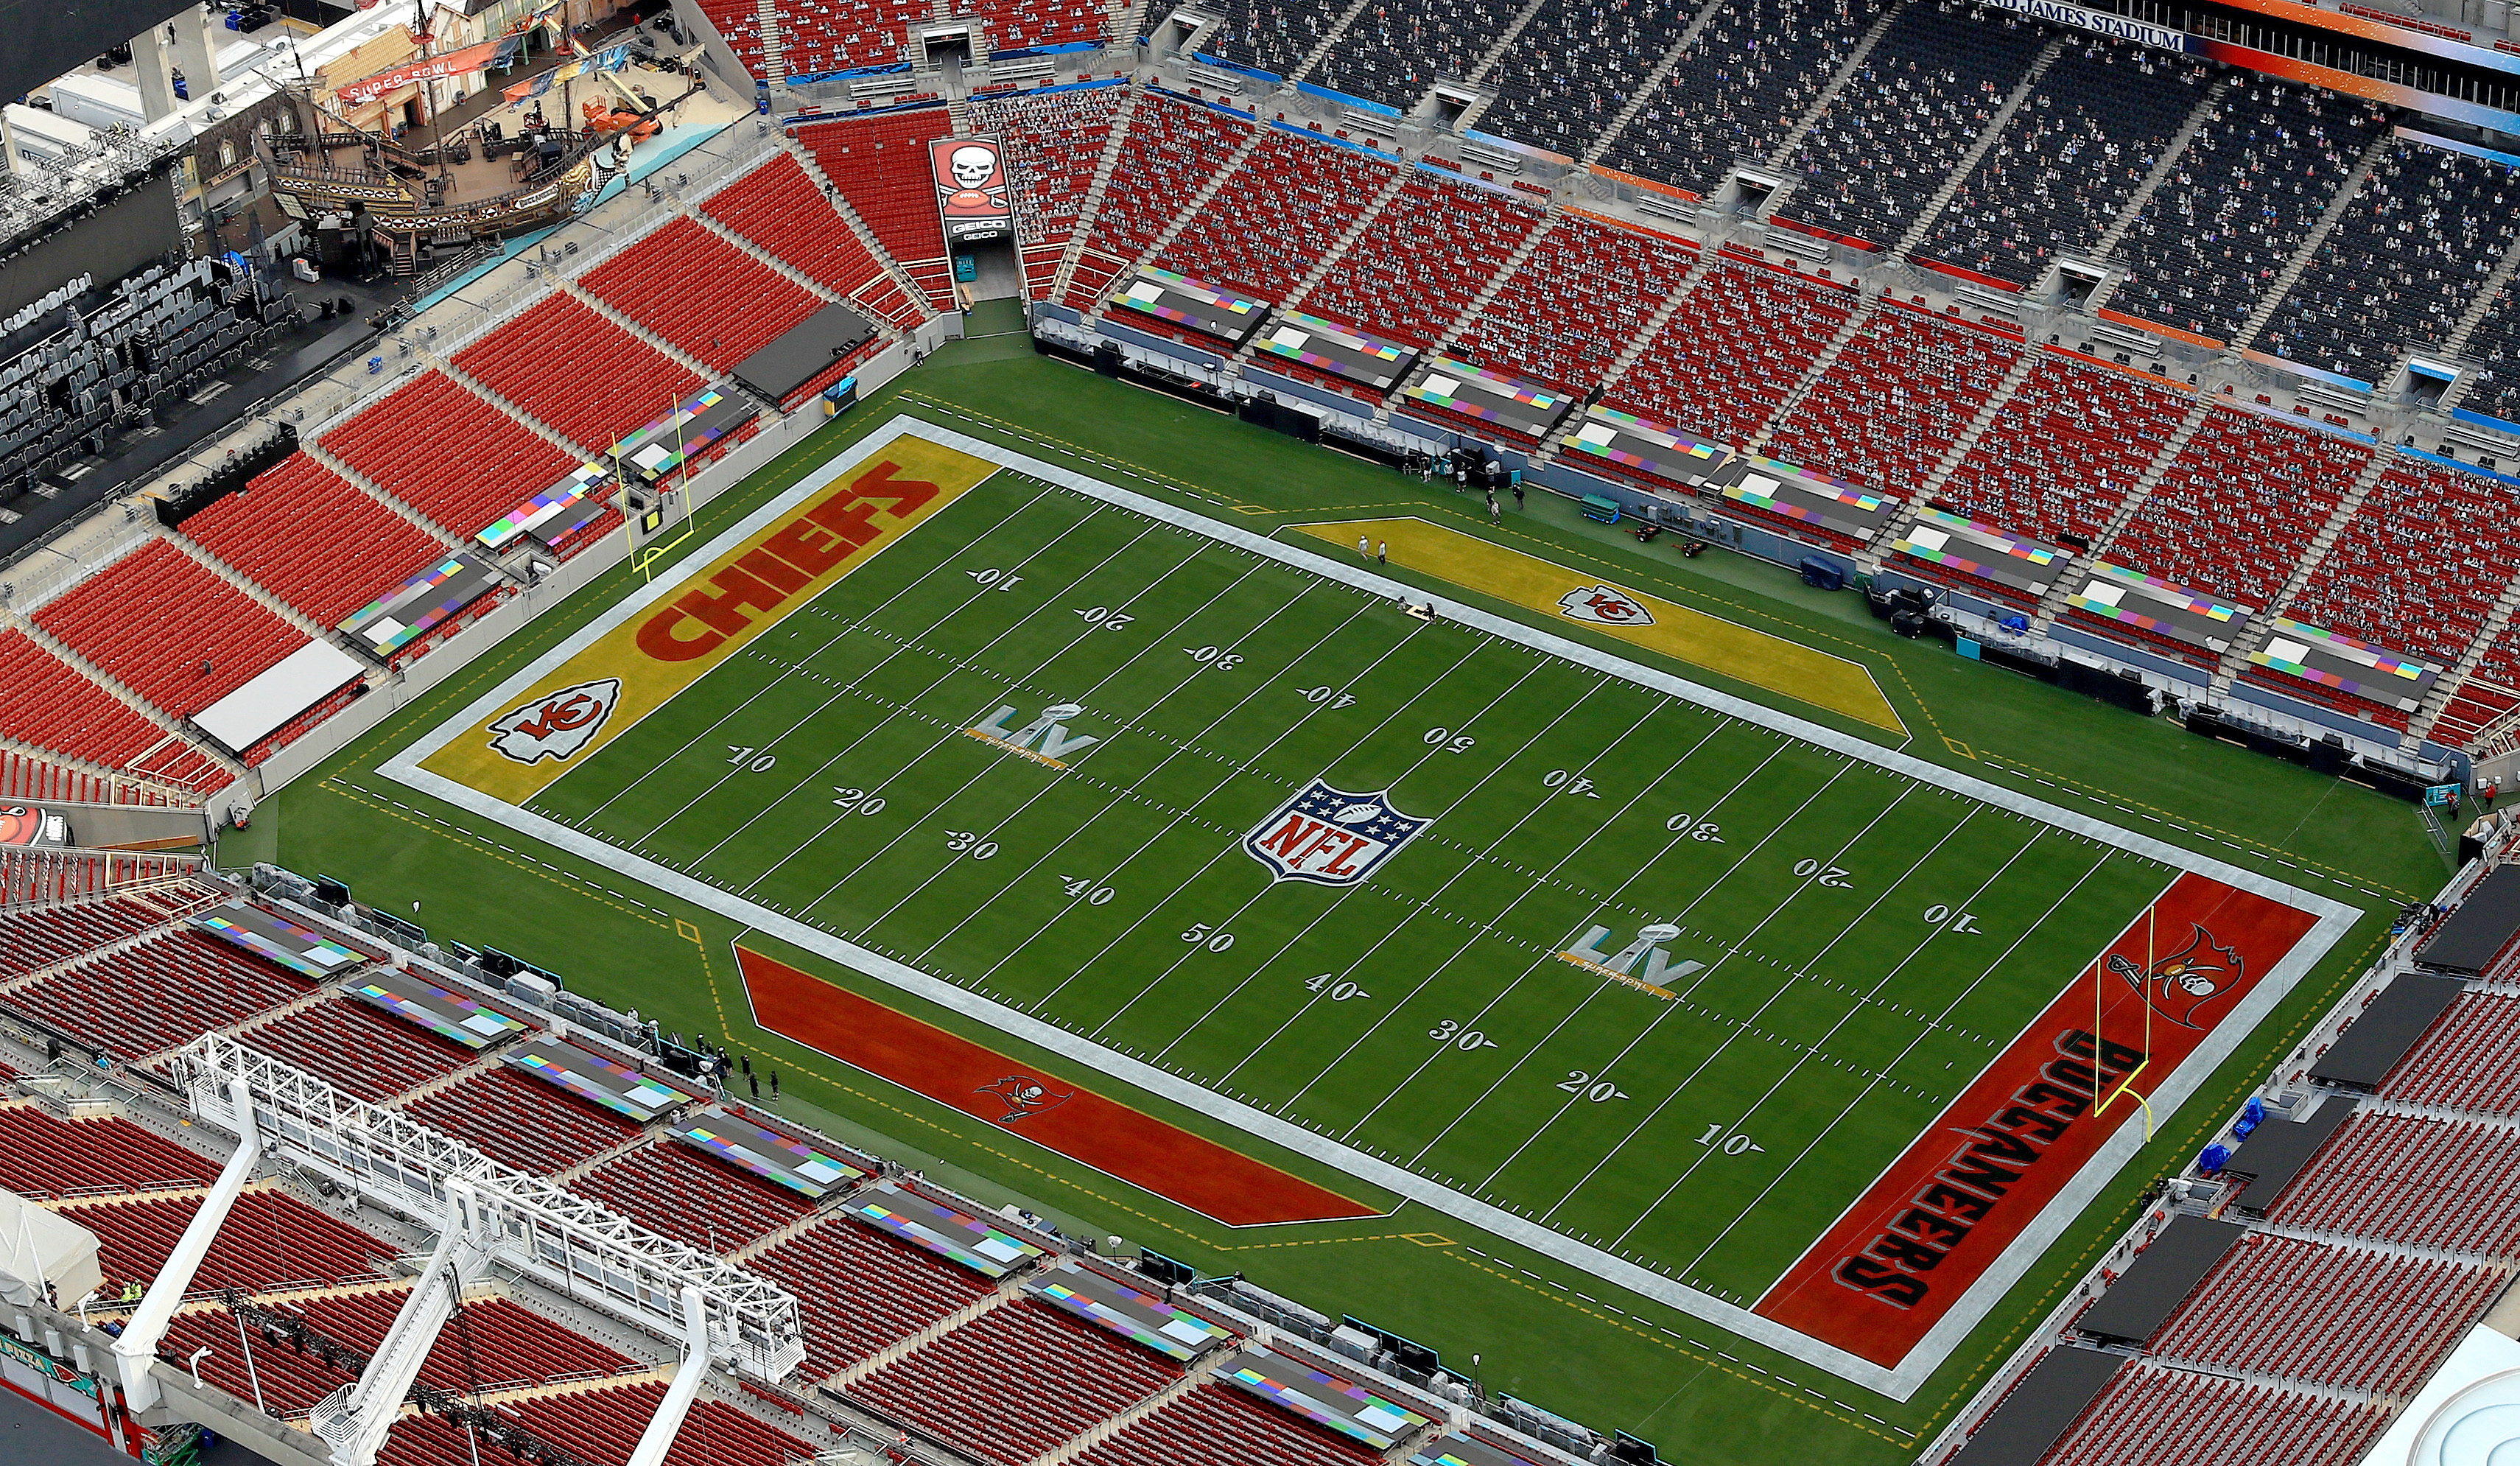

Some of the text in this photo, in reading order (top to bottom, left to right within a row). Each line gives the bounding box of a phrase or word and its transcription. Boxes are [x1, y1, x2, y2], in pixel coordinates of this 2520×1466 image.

[2019, 0, 2086, 27] JAMES
[2092, 15, 2181, 51] STADIUM
[350, 61, 457, 98] SUPER BOWL
[952, 220, 1006, 234] GEICO
[964, 231, 997, 240] GEICO
[636, 460, 940, 662] CHIEFS
[976, 569, 1025, 592] 10
[1084, 606, 1134, 631] 20
[1583, 594, 1637, 620] KC
[1193, 645, 1244, 671] 30
[1308, 686, 1356, 709] 40
[513, 693, 603, 742] KC
[986, 736, 1042, 761] SUPER BOWL
[1423, 727, 1475, 754] 50
[726, 745, 776, 772] 10
[1542, 770, 1594, 799] 40
[832, 788, 886, 816] 20
[1666, 813, 1720, 841] 30
[947, 831, 999, 860] 30
[1259, 815, 1370, 877] NFL
[1793, 858, 1850, 887] 20
[1064, 878, 1115, 905] 40
[1923, 905, 1979, 933] 10
[1182, 922, 1234, 953] 50
[1305, 972, 1358, 1001] 40
[1582, 961, 1647, 989] SUPER BOWL
[1428, 1020, 1484, 1051] 30
[1556, 1070, 1615, 1103] 20
[1694, 1123, 1750, 1155] 10
[1831, 1029, 2151, 1310] BUCCANEERS
[4, 1342, 46, 1369] PIZZA
